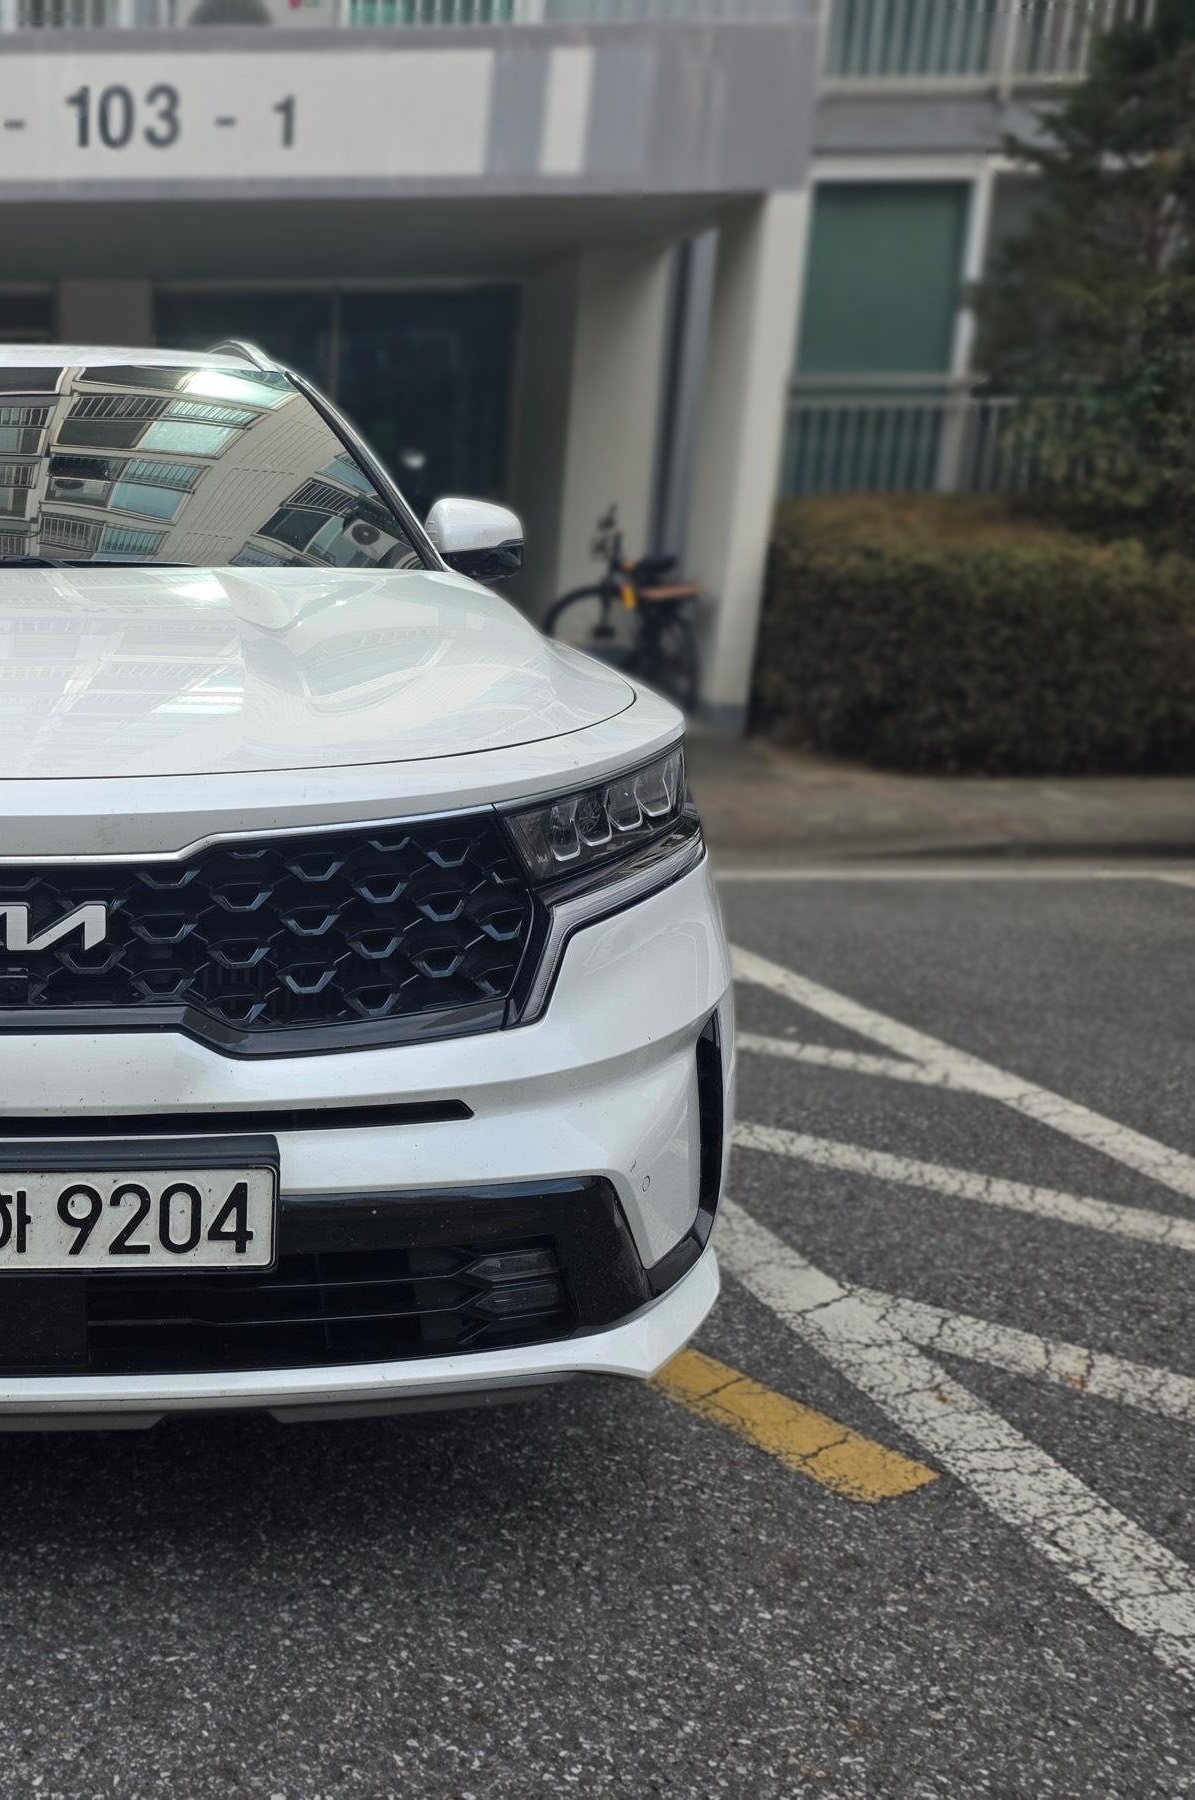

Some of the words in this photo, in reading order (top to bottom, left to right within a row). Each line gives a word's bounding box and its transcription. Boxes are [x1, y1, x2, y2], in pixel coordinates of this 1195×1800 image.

[66, 84, 181, 150] 103
[274, 96, 296, 148] 1
[56, 1182, 254, 1256] 9204
